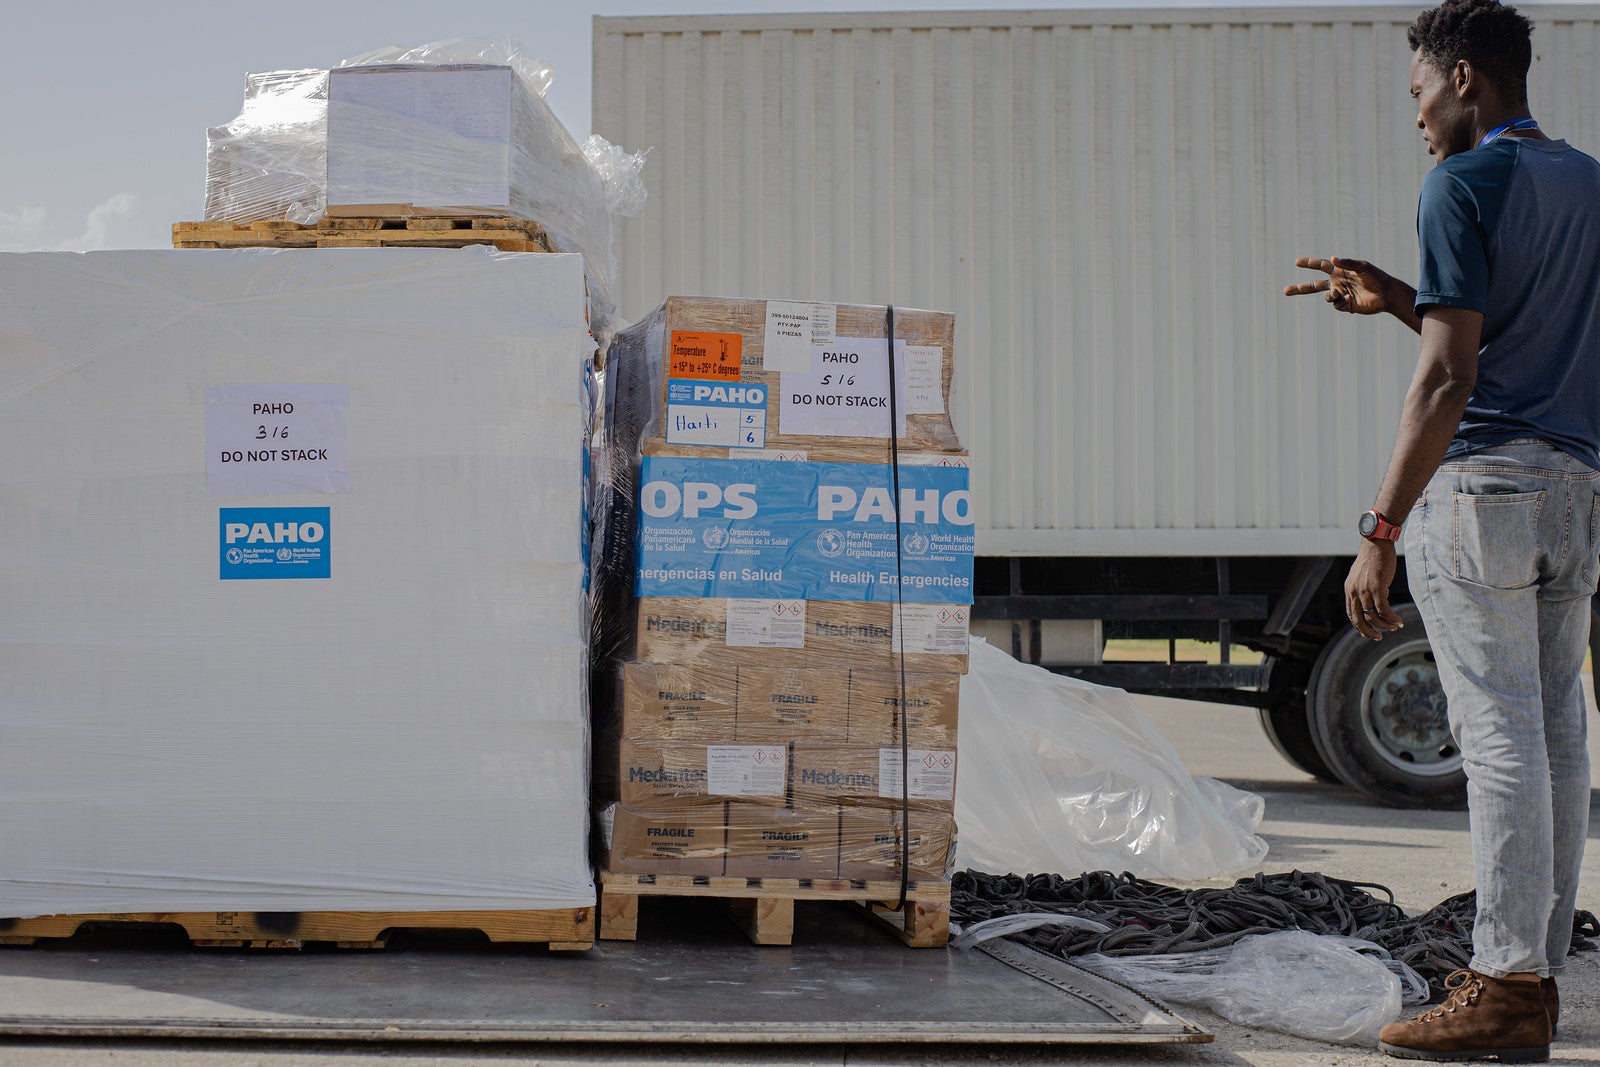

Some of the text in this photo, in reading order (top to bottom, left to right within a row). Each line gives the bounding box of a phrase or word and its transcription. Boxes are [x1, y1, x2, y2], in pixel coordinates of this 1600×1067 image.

[673, 345, 707, 358] Temperature
[822, 352, 859, 364] PAHO
[718, 364, 739, 377] degrees
[694, 385, 765, 404] PAHO
[792, 394, 887, 408] DO NOT STACK
[253, 403, 294, 415] PAHO
[676, 413, 717, 431] Haiti
[745, 415, 756, 424] 5
[746, 431, 755, 443] 6
[221, 448, 328, 463] DO NOT STACK
[640, 480, 758, 520] OPS
[817, 485, 975, 527] PAHO
[225, 521, 325, 544] PAHO
[644, 526, 693, 537] Organización
[729, 528, 771, 538] Organización
[846, 530, 897, 541] Pan American
[644, 536, 696, 545] Panamericana
[729, 537, 754, 545] Mundial
[771, 538, 789, 546] Salud
[846, 539, 872, 548] Health
[930, 534, 975, 543] World Health
[664, 544, 685, 552] Salud
[846, 548, 896, 560] Organization
[930, 543, 975, 554] Organization
[719, 570, 737, 580] en
[741, 568, 782, 582] Salud
[830, 570, 969, 588] Health Emergencies
[658, 691, 706, 701] FRAGILE
[771, 693, 819, 704] FRAGILE
[647, 827, 695, 838] FRAGILE
[762, 830, 809, 841] FRAGILE
